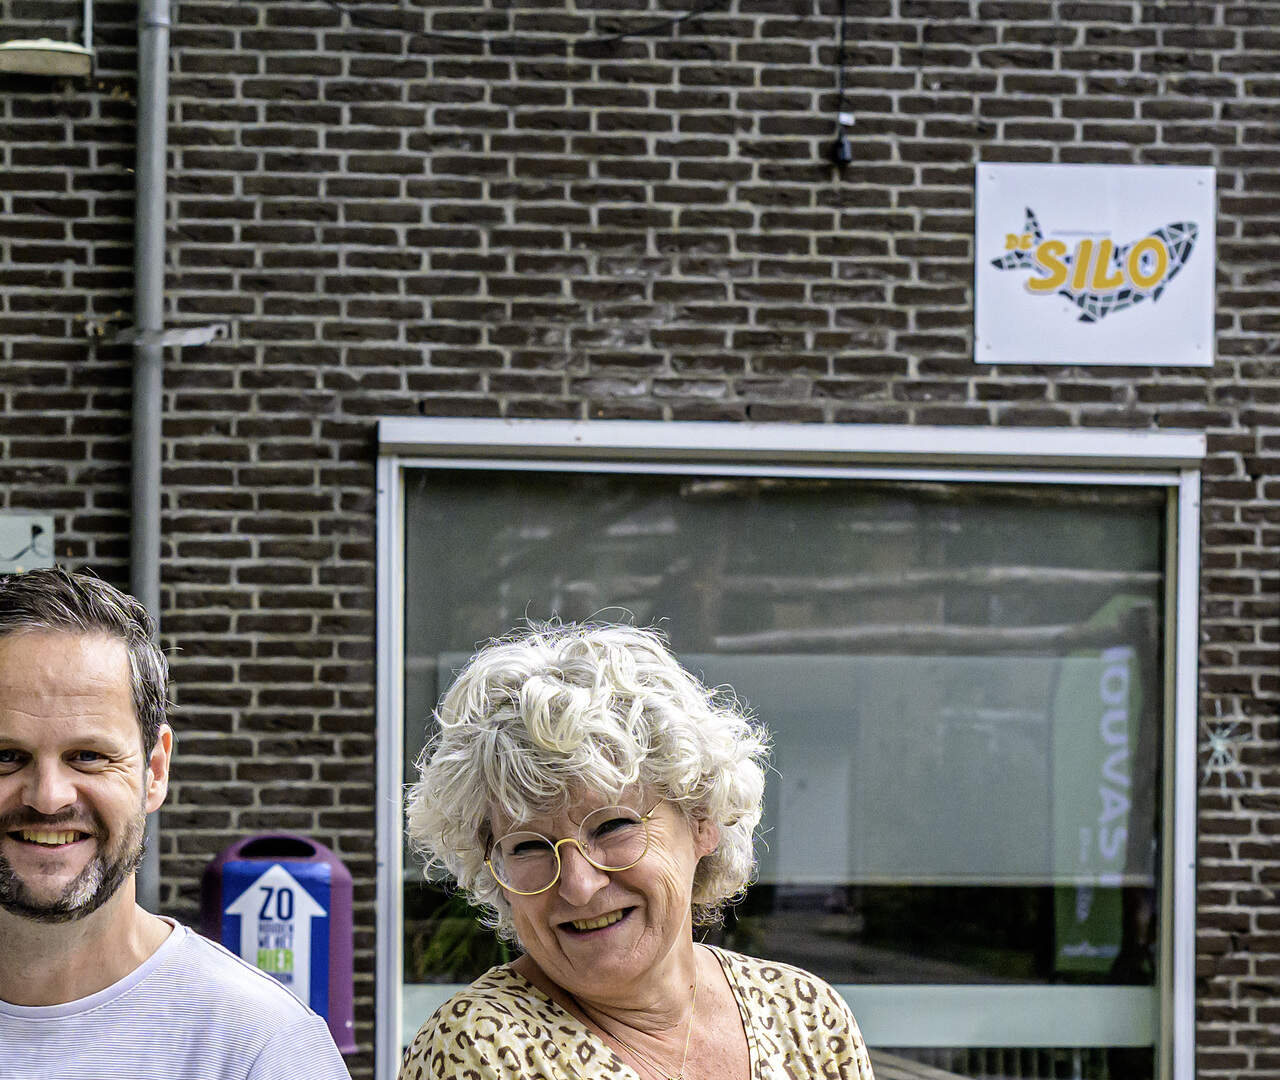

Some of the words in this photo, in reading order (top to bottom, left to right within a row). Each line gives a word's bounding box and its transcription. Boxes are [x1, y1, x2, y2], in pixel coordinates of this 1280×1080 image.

[1004, 233, 1033, 250] DE
[1027, 236, 1169, 292] SILO
[258, 886, 294, 921] ZO
